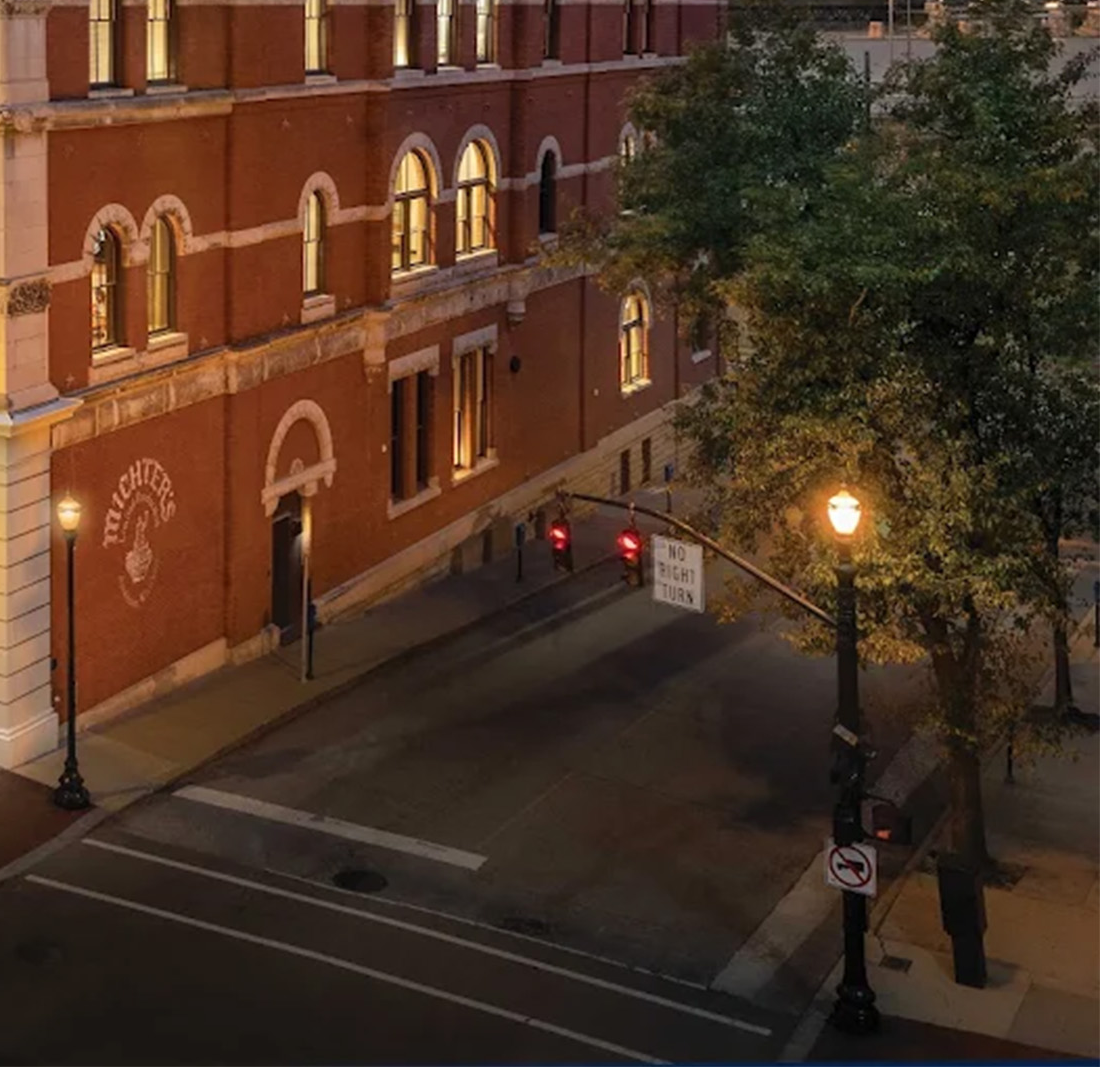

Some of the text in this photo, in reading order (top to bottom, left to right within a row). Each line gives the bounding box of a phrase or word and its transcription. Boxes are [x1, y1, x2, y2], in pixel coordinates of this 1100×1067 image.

[102, 458, 176, 548] MICHTER'S
[668, 544, 686, 562] NO
[660, 561, 695, 584] RIGHT
[663, 583, 693, 604] TURN
